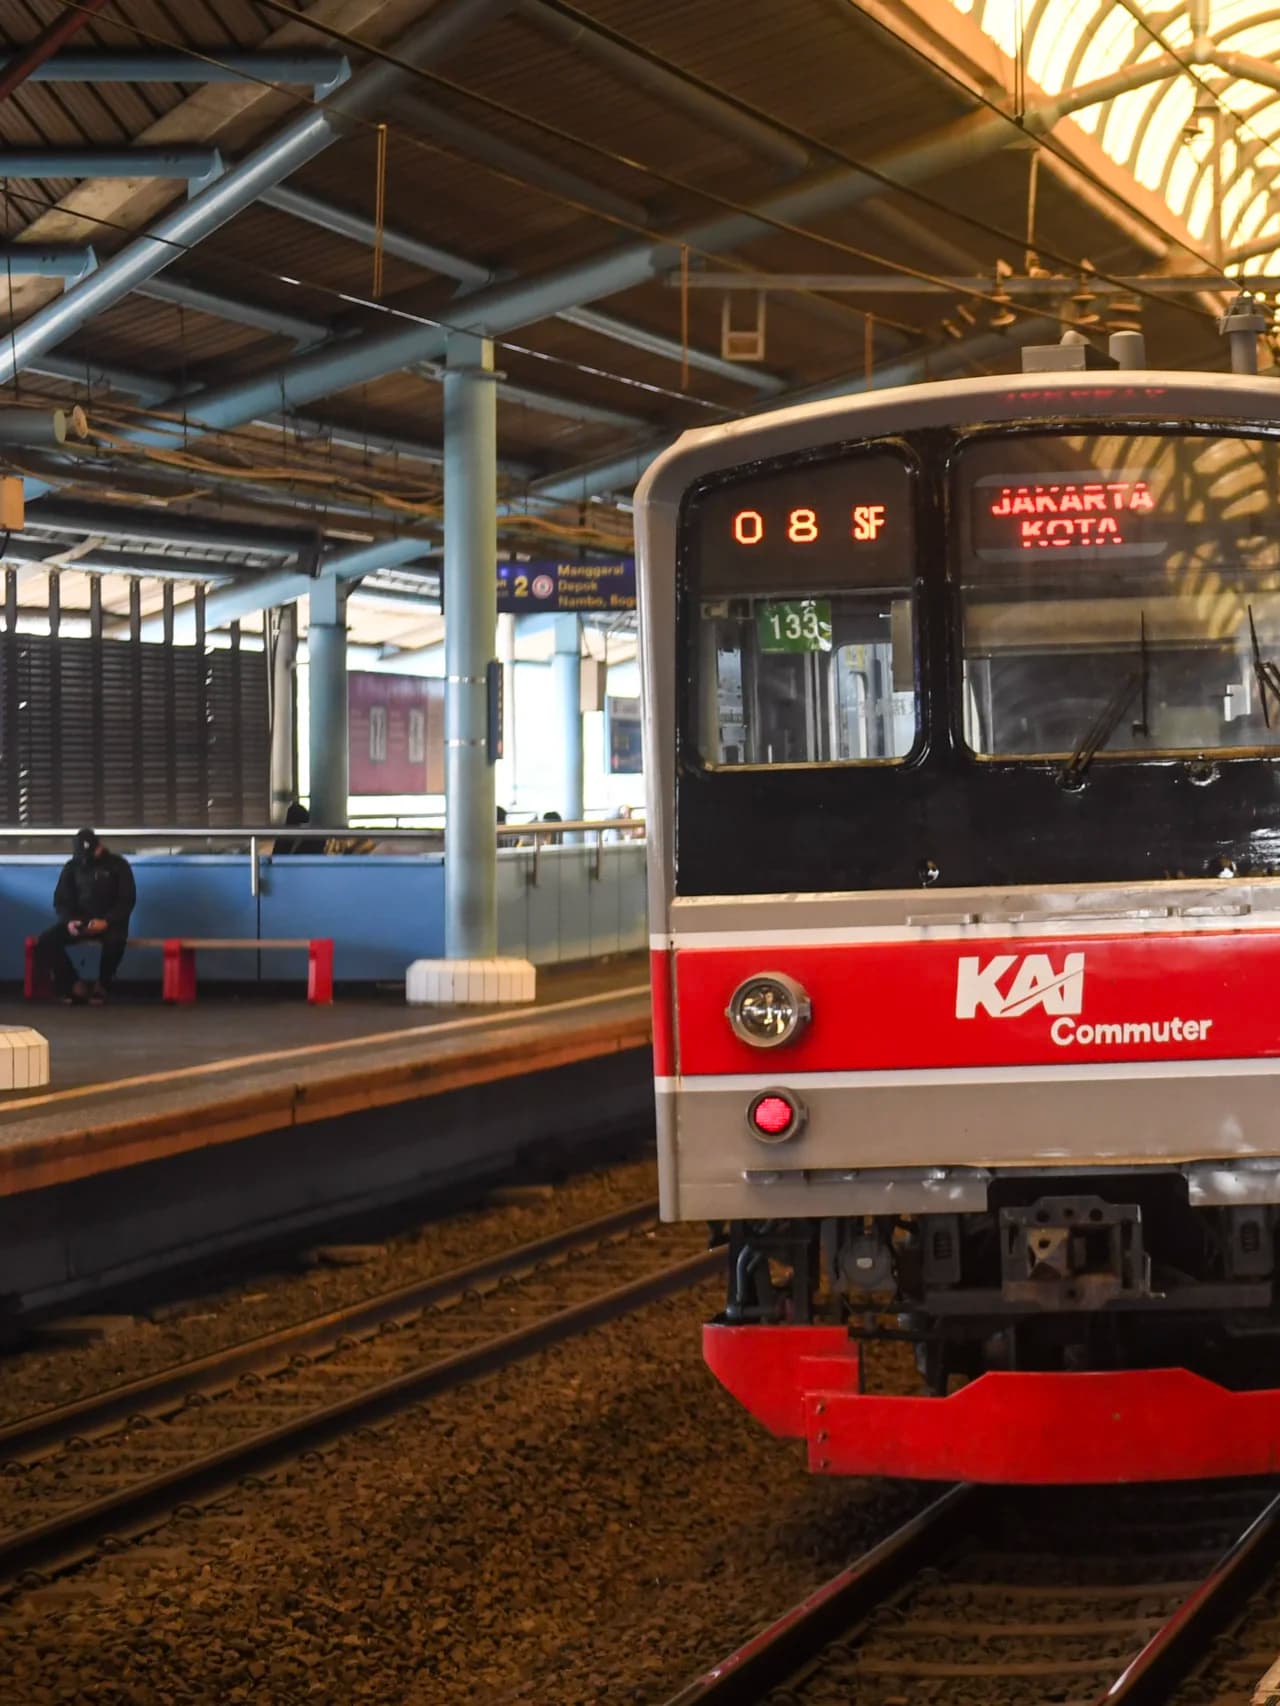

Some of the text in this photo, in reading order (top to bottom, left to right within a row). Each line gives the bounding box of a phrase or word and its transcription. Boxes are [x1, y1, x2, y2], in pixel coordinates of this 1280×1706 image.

[992, 483, 1154, 515] JAKARTA
[853, 505, 886, 540] SF
[1021, 517, 1123, 548] KOTA
[514, 575, 529, 598] 2
[558, 580, 598, 593] Depok
[610, 593, 636, 609] Bog
[770, 613, 818, 640] 133
[955, 952, 1085, 1019] KAI
[1050, 1017, 1213, 1046] Commuter
